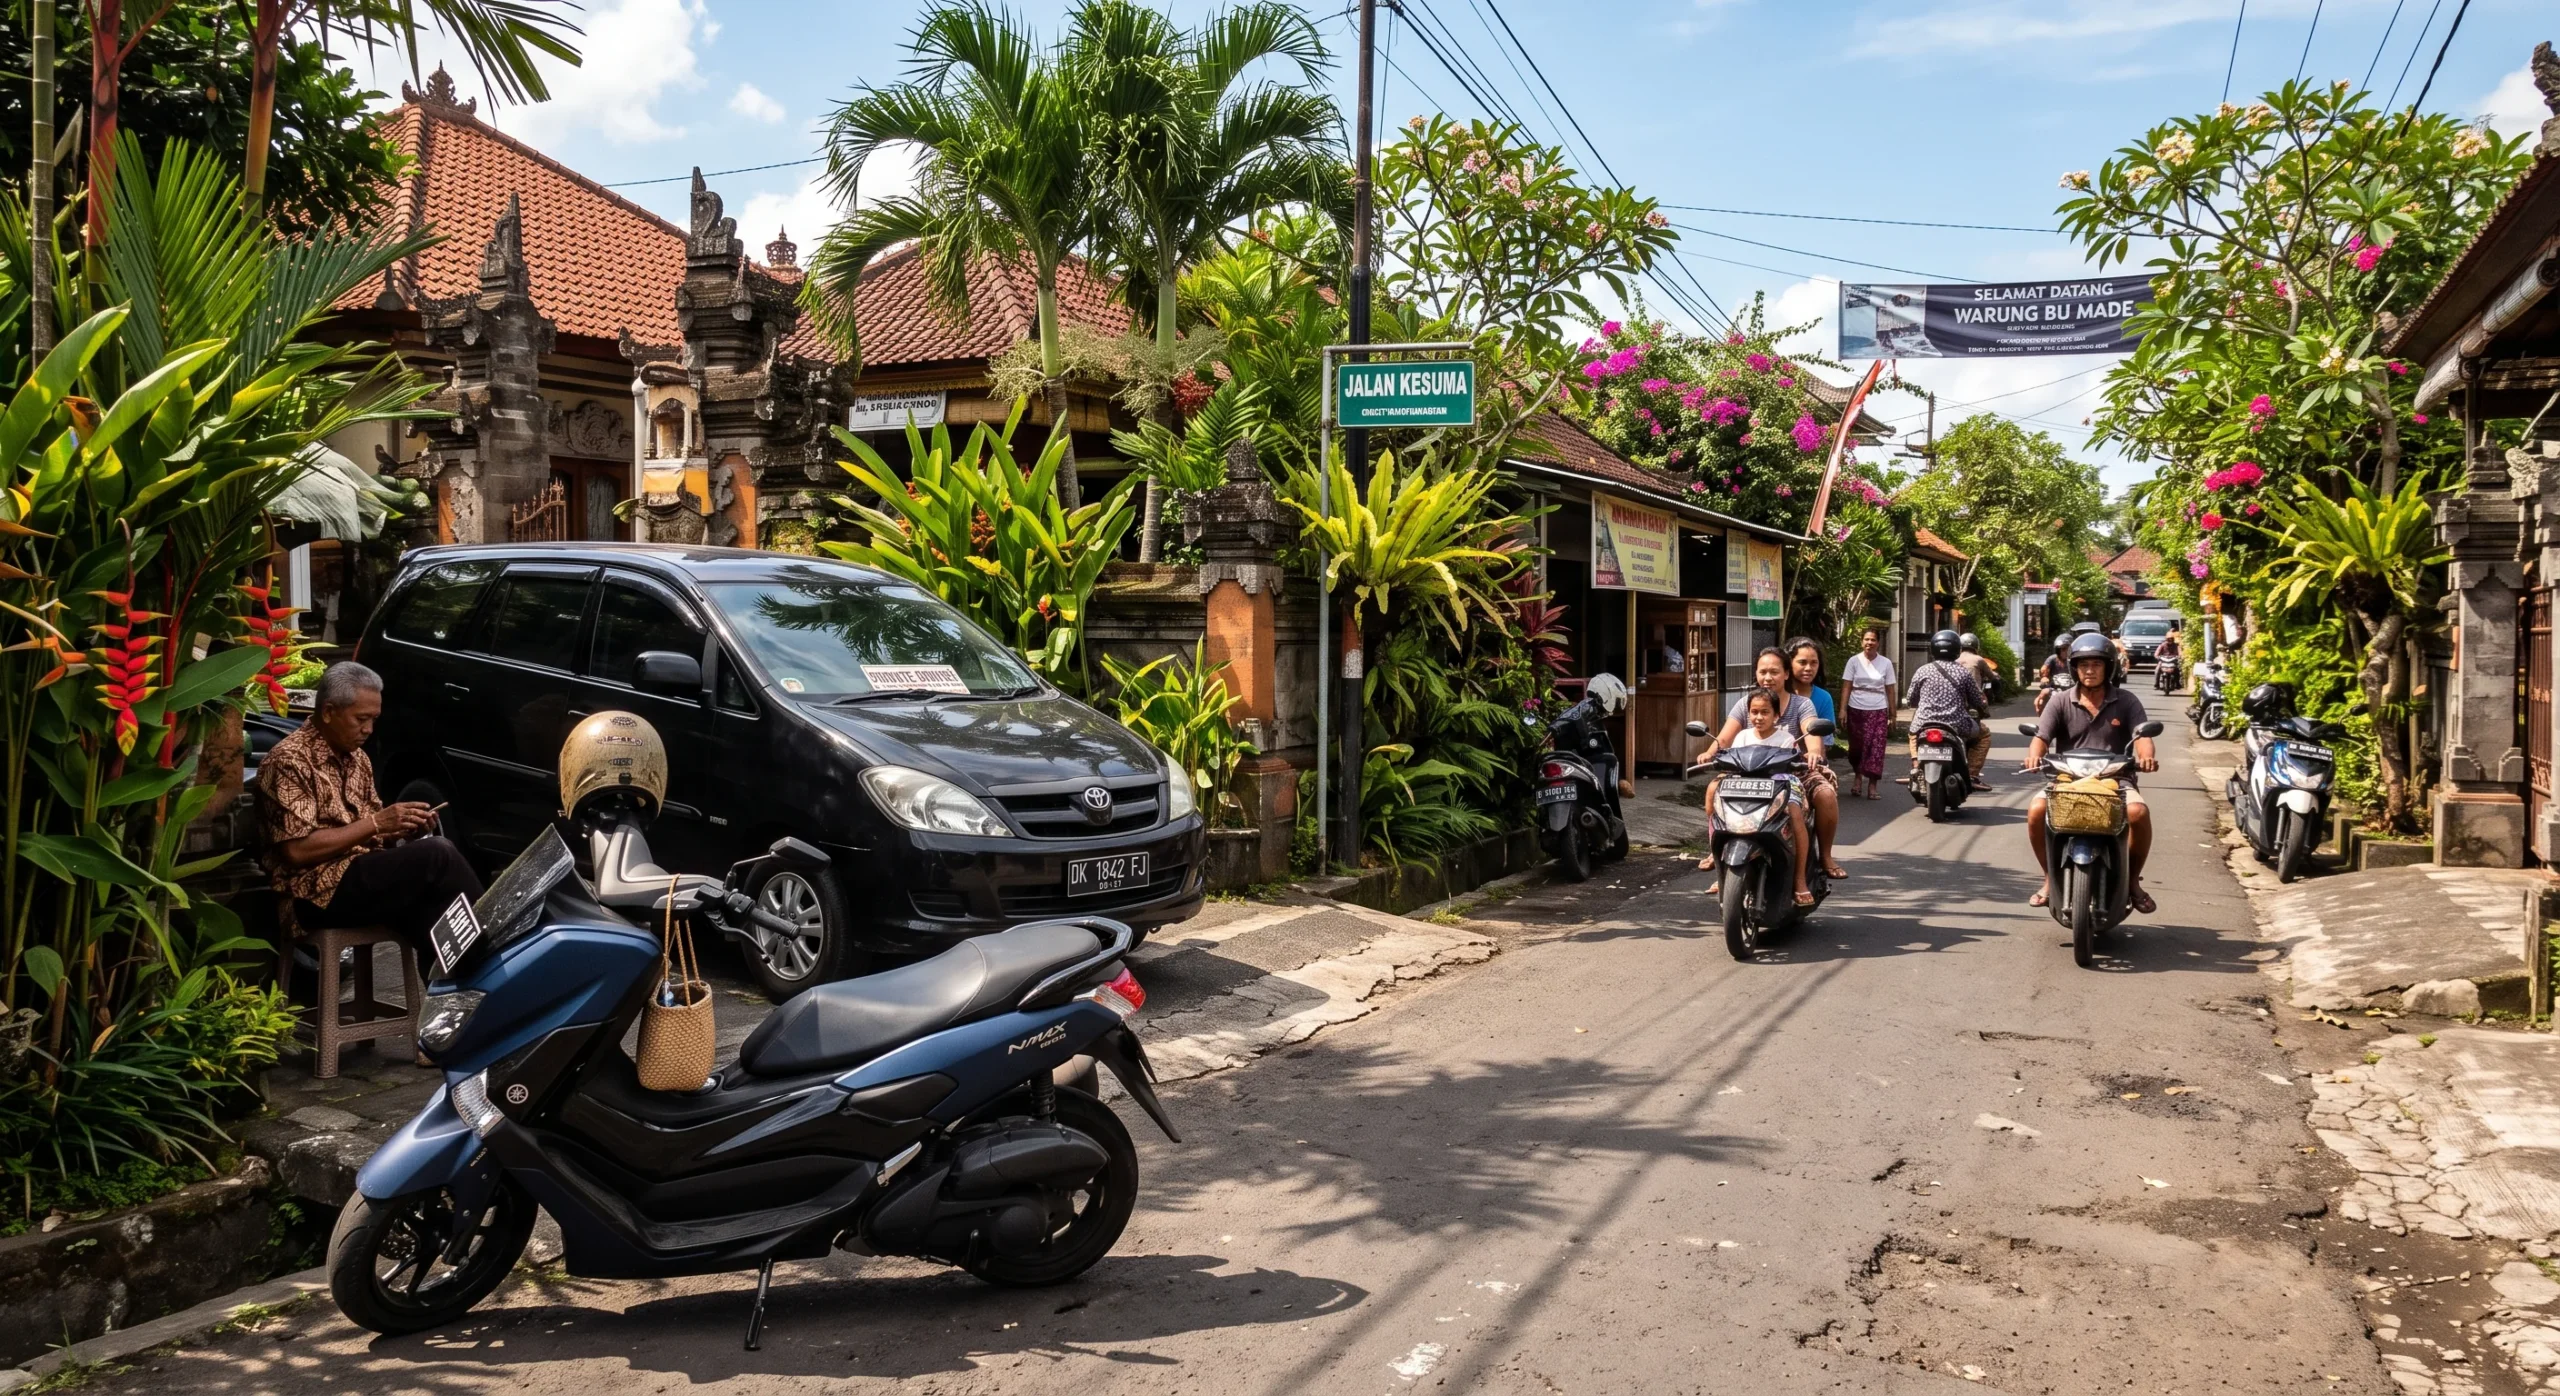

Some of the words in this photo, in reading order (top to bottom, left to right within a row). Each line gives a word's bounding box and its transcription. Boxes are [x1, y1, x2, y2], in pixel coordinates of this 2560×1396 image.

[1974, 286, 2046, 301] SELAMAT
[2050, 283, 2114, 298] DATANG
[1954, 305, 2038, 324] WARUNG
[2045, 304, 2070, 321] BU
[2076, 300, 2134, 320] MADE
[1344, 372, 1395, 398] JALAN
[1400, 371, 1467, 396] KESUMA
[1071, 862, 1088, 885] DK
[1096, 858, 1125, 881] 1842
[1131, 855, 1146, 877] FJ
[1007, 1020, 1068, 1055] NMAX
